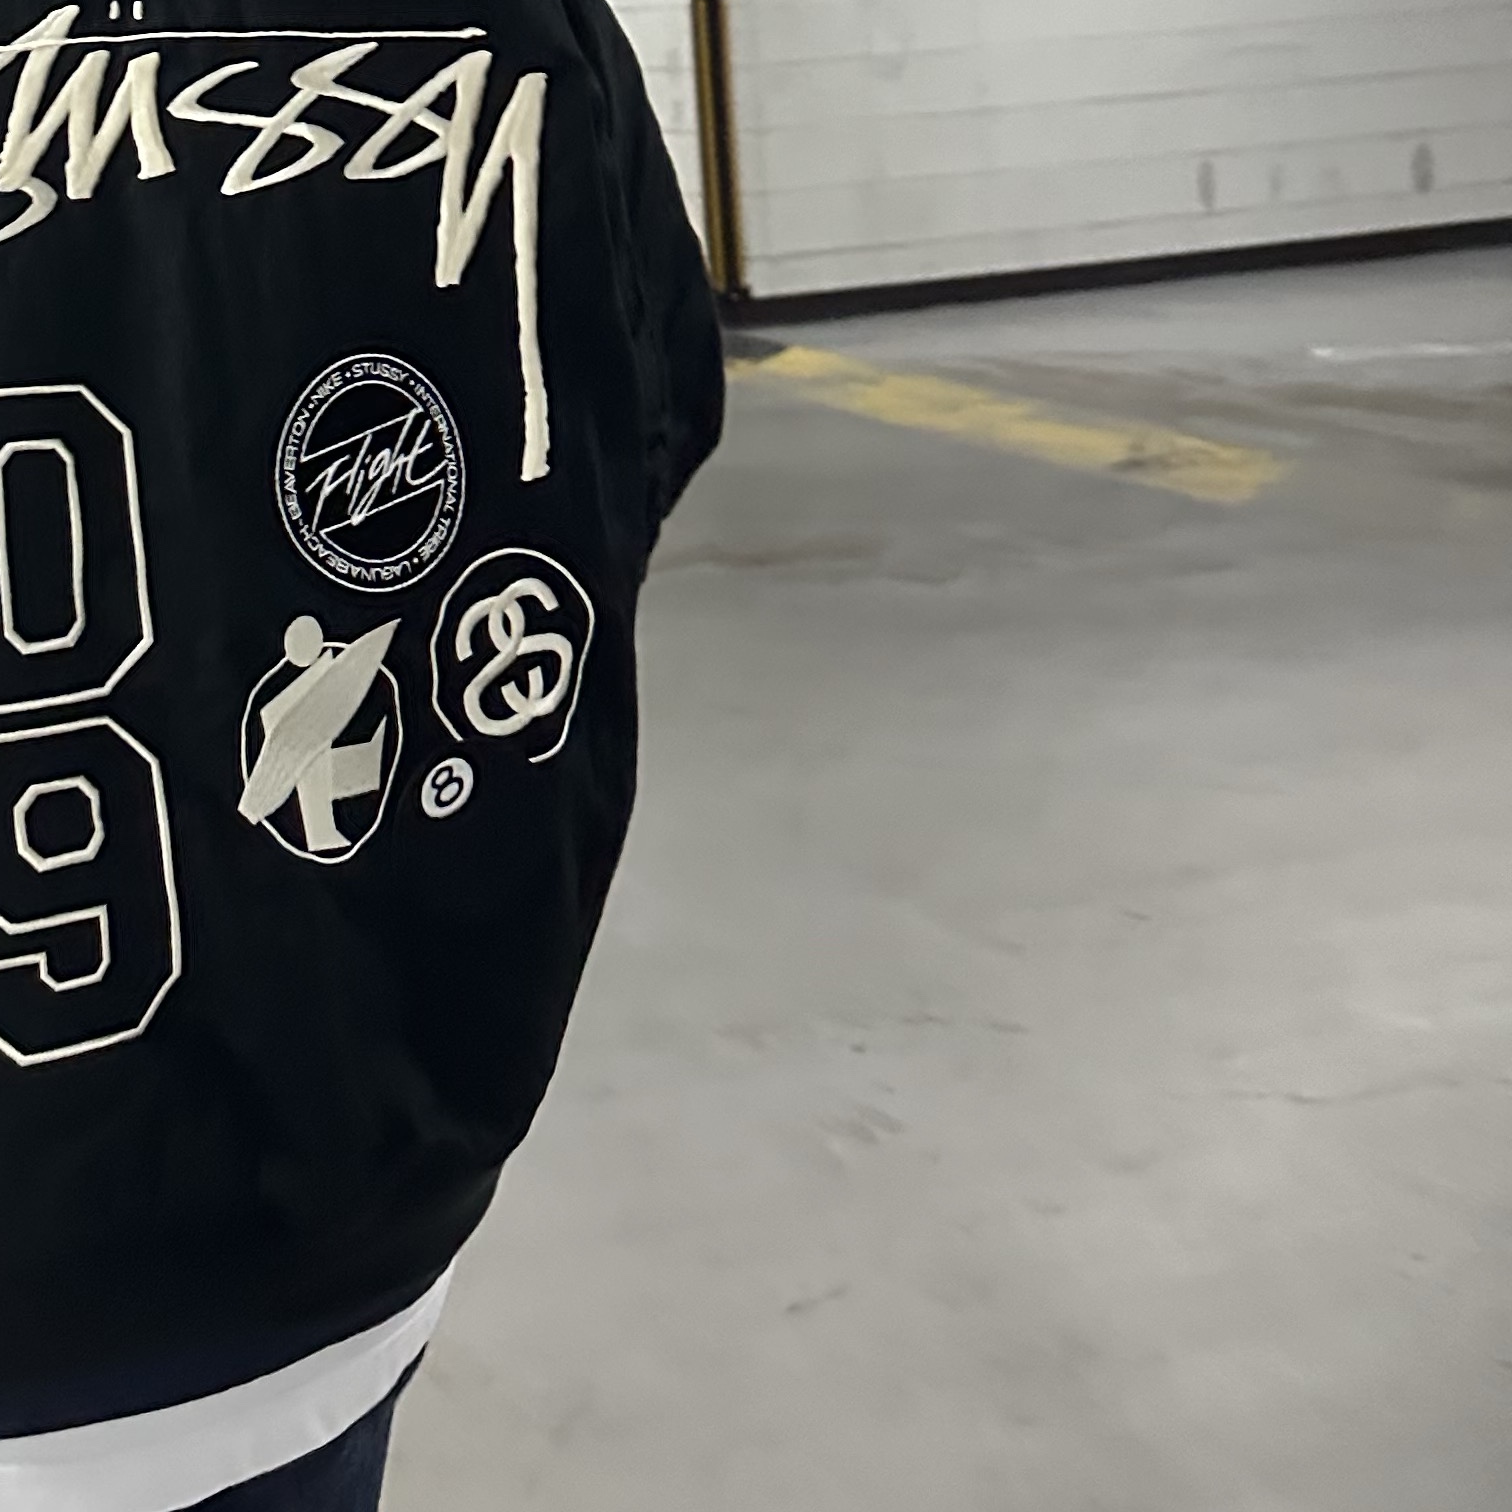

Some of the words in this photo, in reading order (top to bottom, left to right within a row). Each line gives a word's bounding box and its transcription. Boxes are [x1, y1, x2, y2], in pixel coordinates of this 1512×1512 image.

[310, 370, 345, 406] NIKE
[350, 361, 410, 383] STUSSY
[283, 407, 312, 520] BEAVERTON
[304, 408, 450, 533] Flight
[413, 383, 460, 513] INTERNATIONAL
